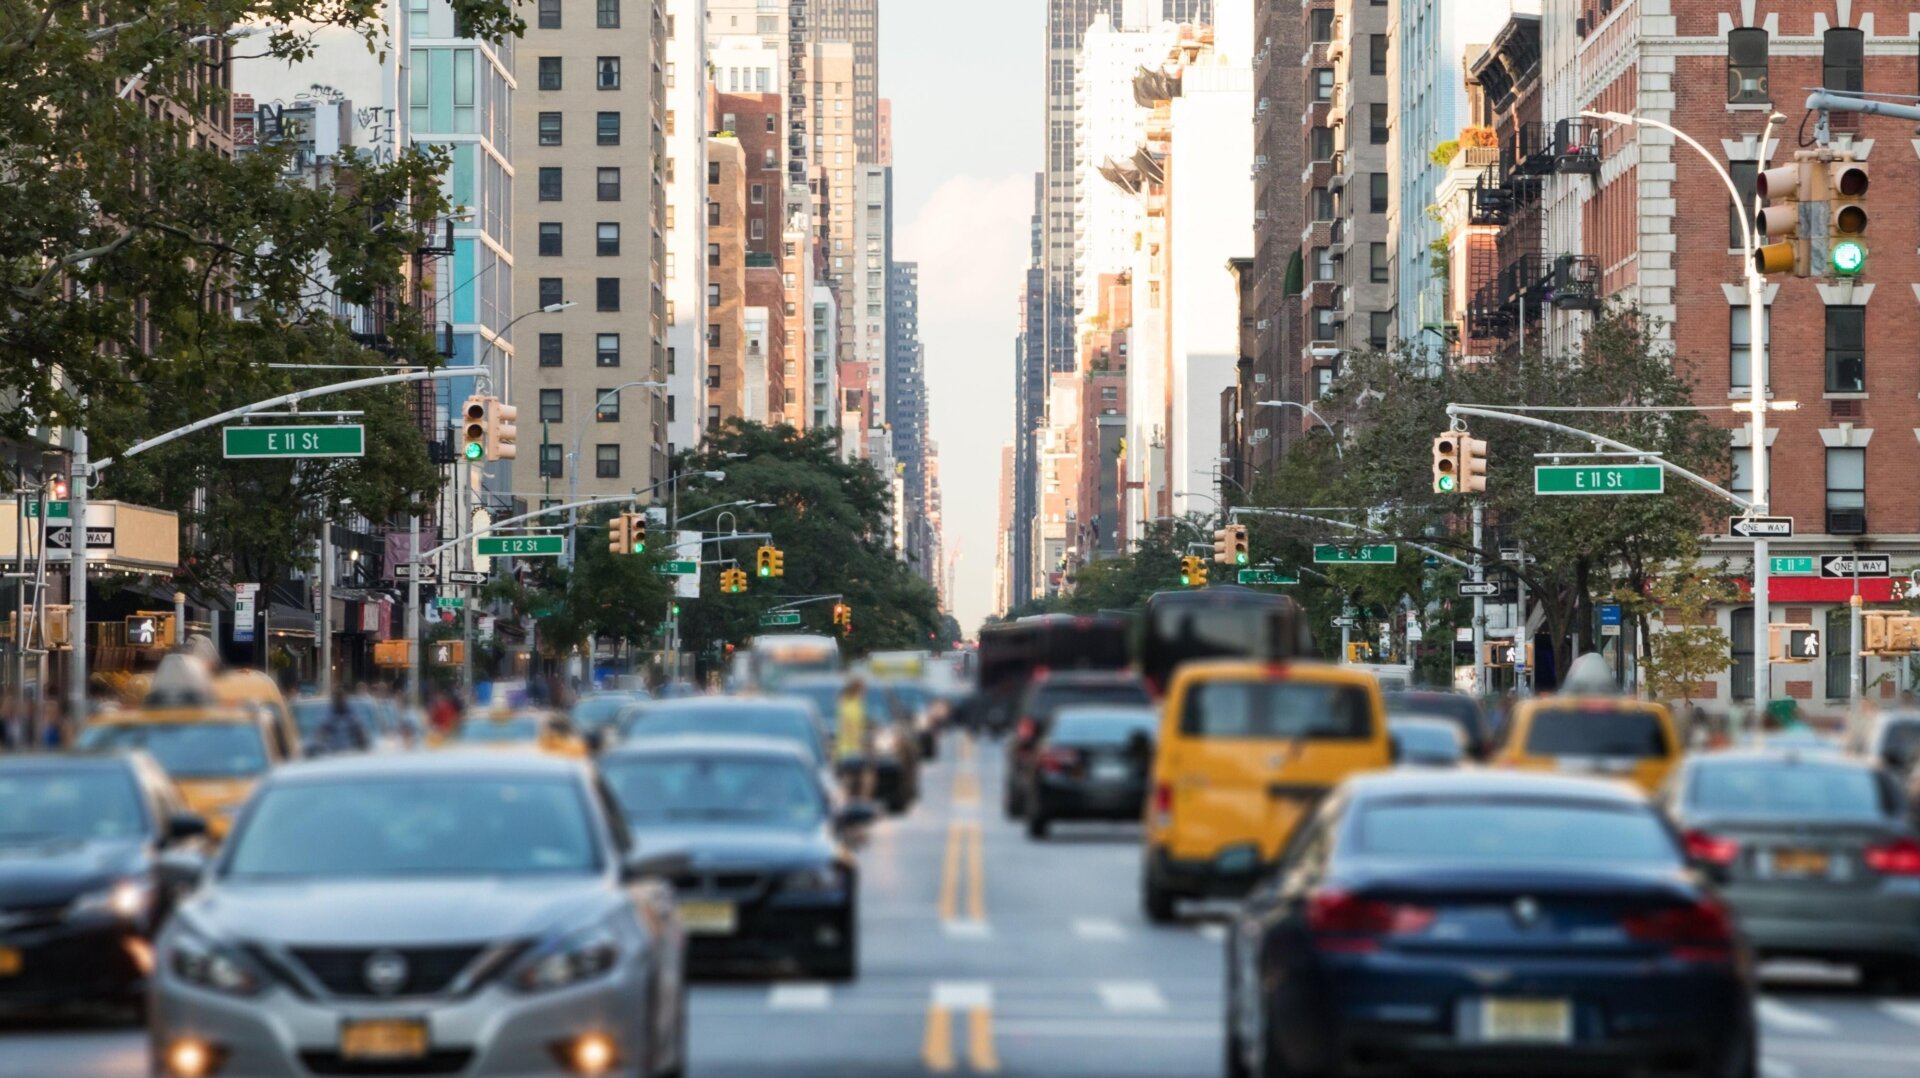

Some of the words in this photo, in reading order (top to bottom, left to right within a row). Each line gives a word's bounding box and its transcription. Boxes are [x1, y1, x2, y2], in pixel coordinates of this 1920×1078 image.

[268, 433, 278, 450] E
[285, 433, 295, 450] 11
[302, 432, 319, 450] St
[1576, 472, 1585, 488] E
[1591, 472, 1600, 488] 11
[1607, 471, 1622, 487] St
[29, 503, 37, 516] E
[1741, 524, 1759, 532] ONE
[1768, 524, 1786, 532] WAY
[58, 533, 71, 542] ON
[86, 533, 107, 543] WAY
[502, 541, 509, 552] E
[513, 540, 523, 552] 12
[527, 540, 538, 552] St
[1361, 548, 1372, 559] St
[1776, 559, 1783, 571] E
[1787, 559, 1794, 571] 11
[1834, 562, 1853, 572] ONE
[1862, 562, 1882, 571] WAY
